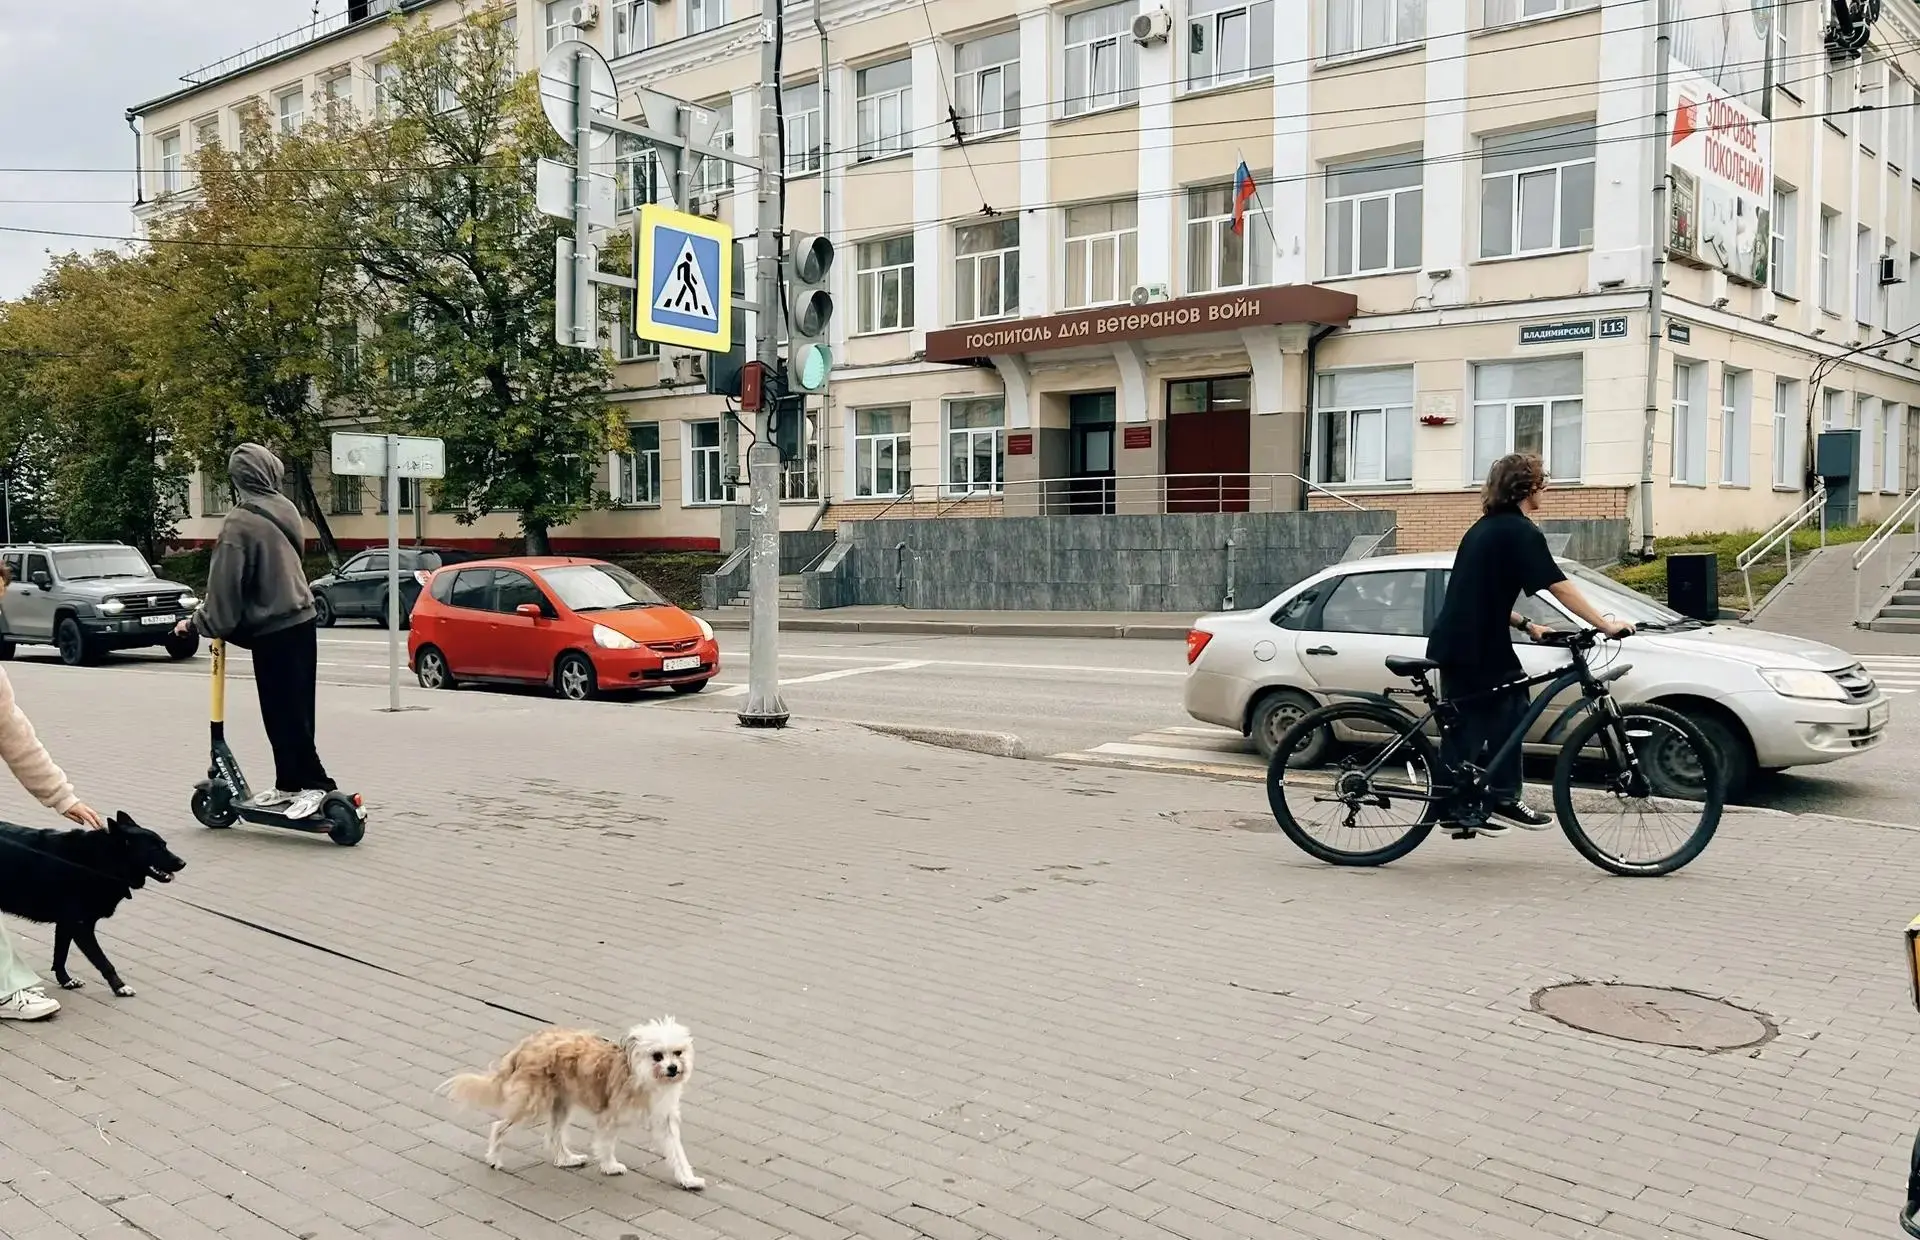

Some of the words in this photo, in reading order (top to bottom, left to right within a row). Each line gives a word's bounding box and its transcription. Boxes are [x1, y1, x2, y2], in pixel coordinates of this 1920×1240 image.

[1705, 93, 1757, 153] ЗДОРОВЬЕ
[1705, 135, 1764, 197] ПОКОЛЕНИЙ
[1523, 326, 1591, 340] ВЛАДИМИРСКАЯ
[1602, 321, 1625, 334] 113
